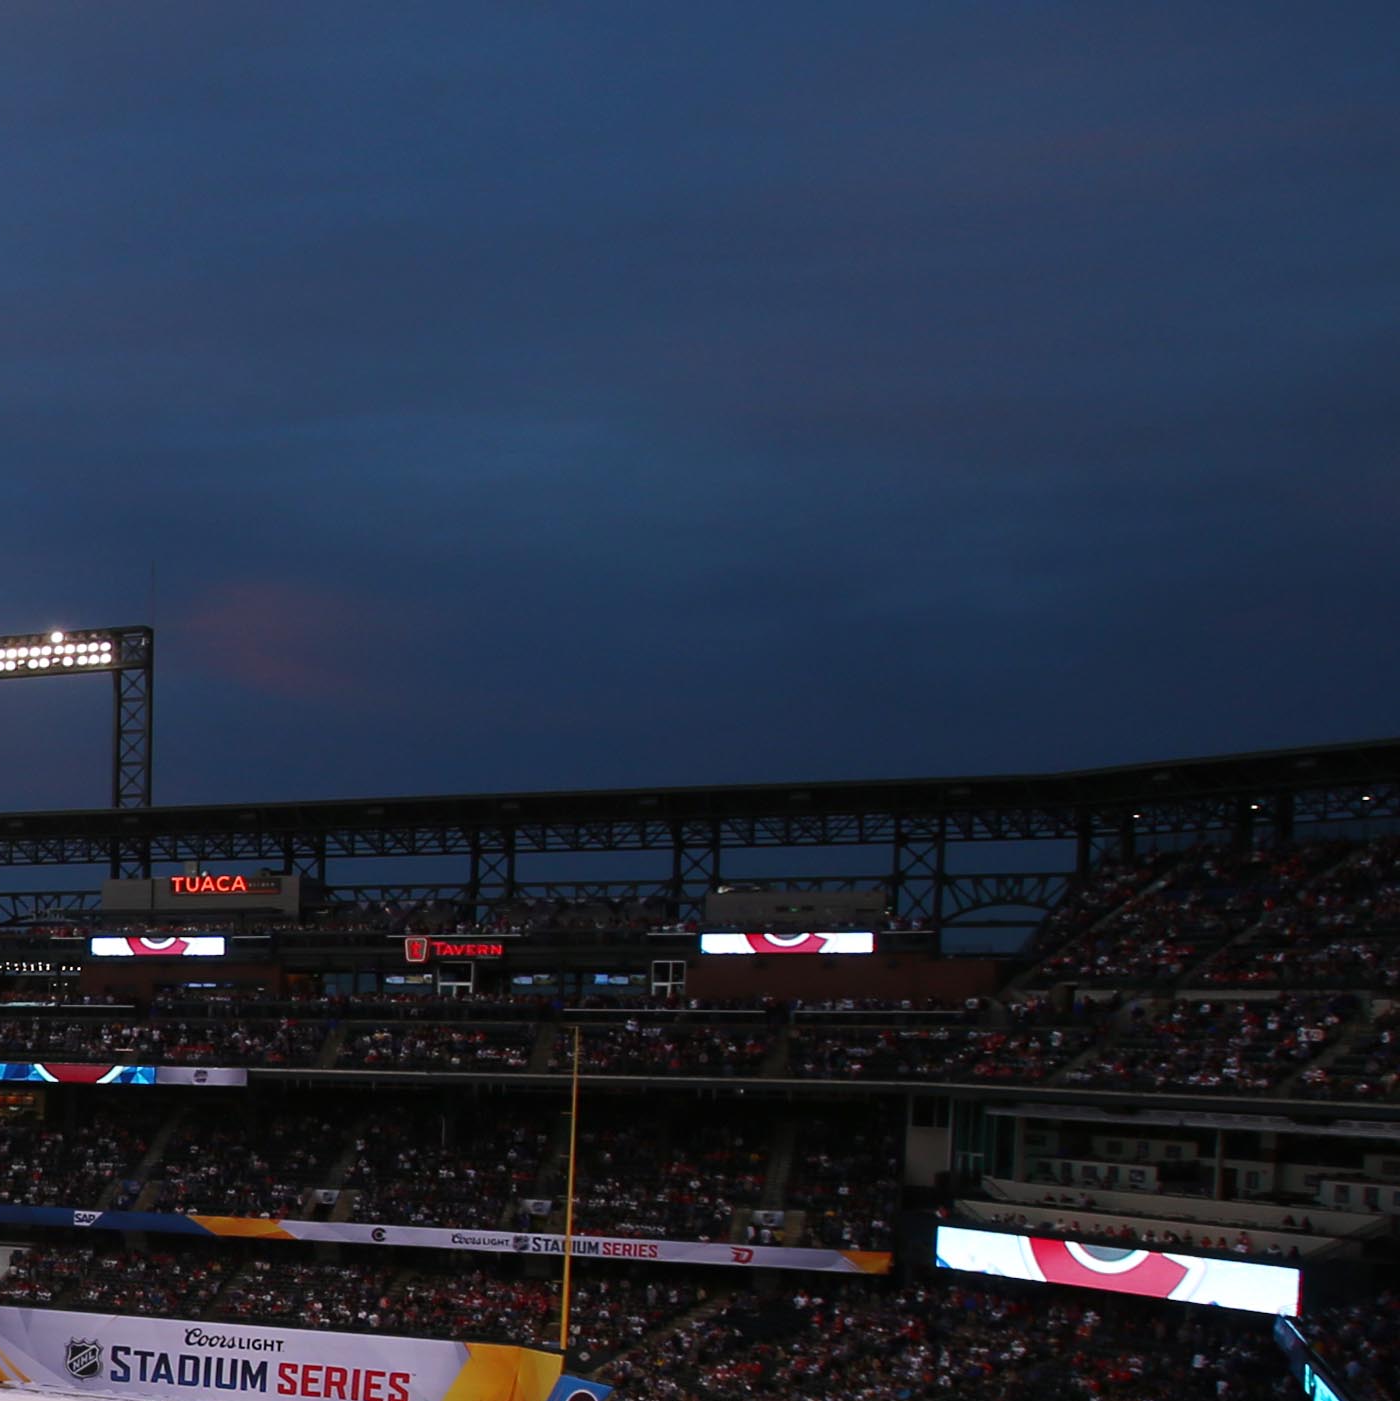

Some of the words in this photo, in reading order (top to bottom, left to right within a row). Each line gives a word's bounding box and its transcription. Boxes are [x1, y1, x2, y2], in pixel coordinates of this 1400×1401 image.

[171, 875, 247, 892] TUACA
[432, 941, 504, 956] TAVERN
[74, 1211, 96, 1224] SAP
[451, 1232, 481, 1246] Coors
[481, 1235, 510, 1247] LIGHT
[602, 1241, 658, 1260] SERIES
[184, 1327, 236, 1350] Coors
[236, 1335, 284, 1353] LIGHT
[110, 1345, 268, 1393] STADIUM
